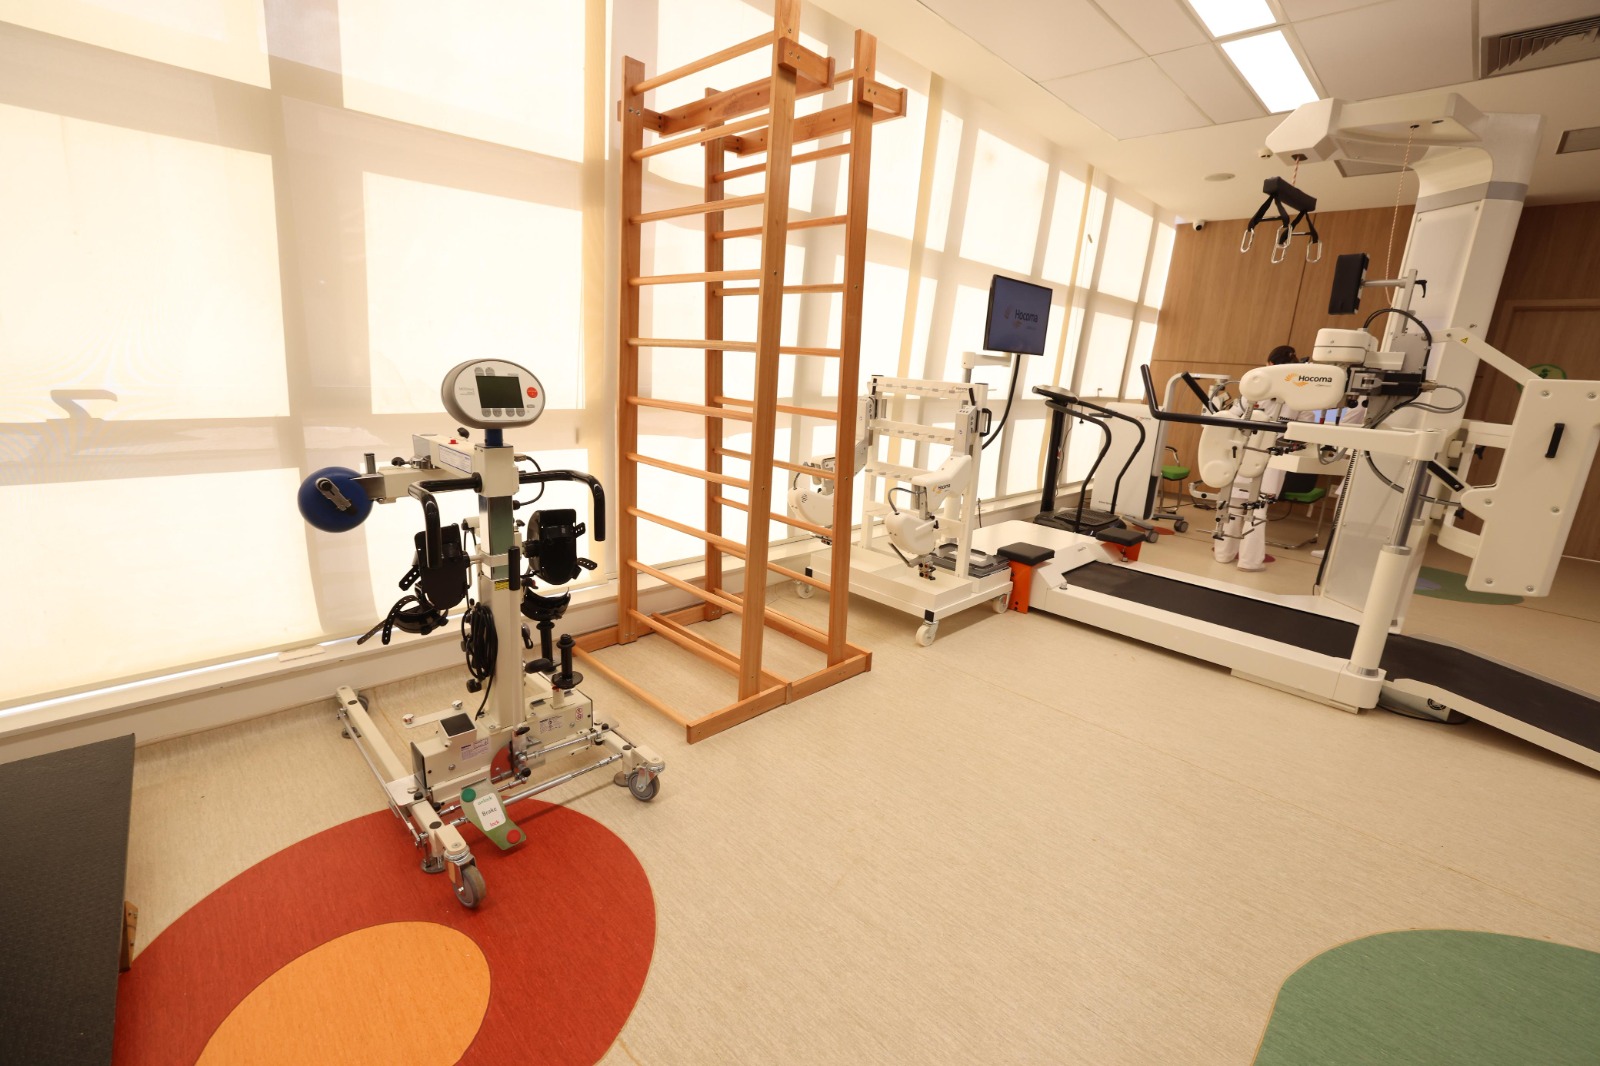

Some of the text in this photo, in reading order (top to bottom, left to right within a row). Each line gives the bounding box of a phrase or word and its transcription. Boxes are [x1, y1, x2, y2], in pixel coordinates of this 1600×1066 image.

[1014, 308, 1039, 323] Hocoma
[1298, 375, 1333, 383] Hocoma
[481, 807, 497, 817] Brake
